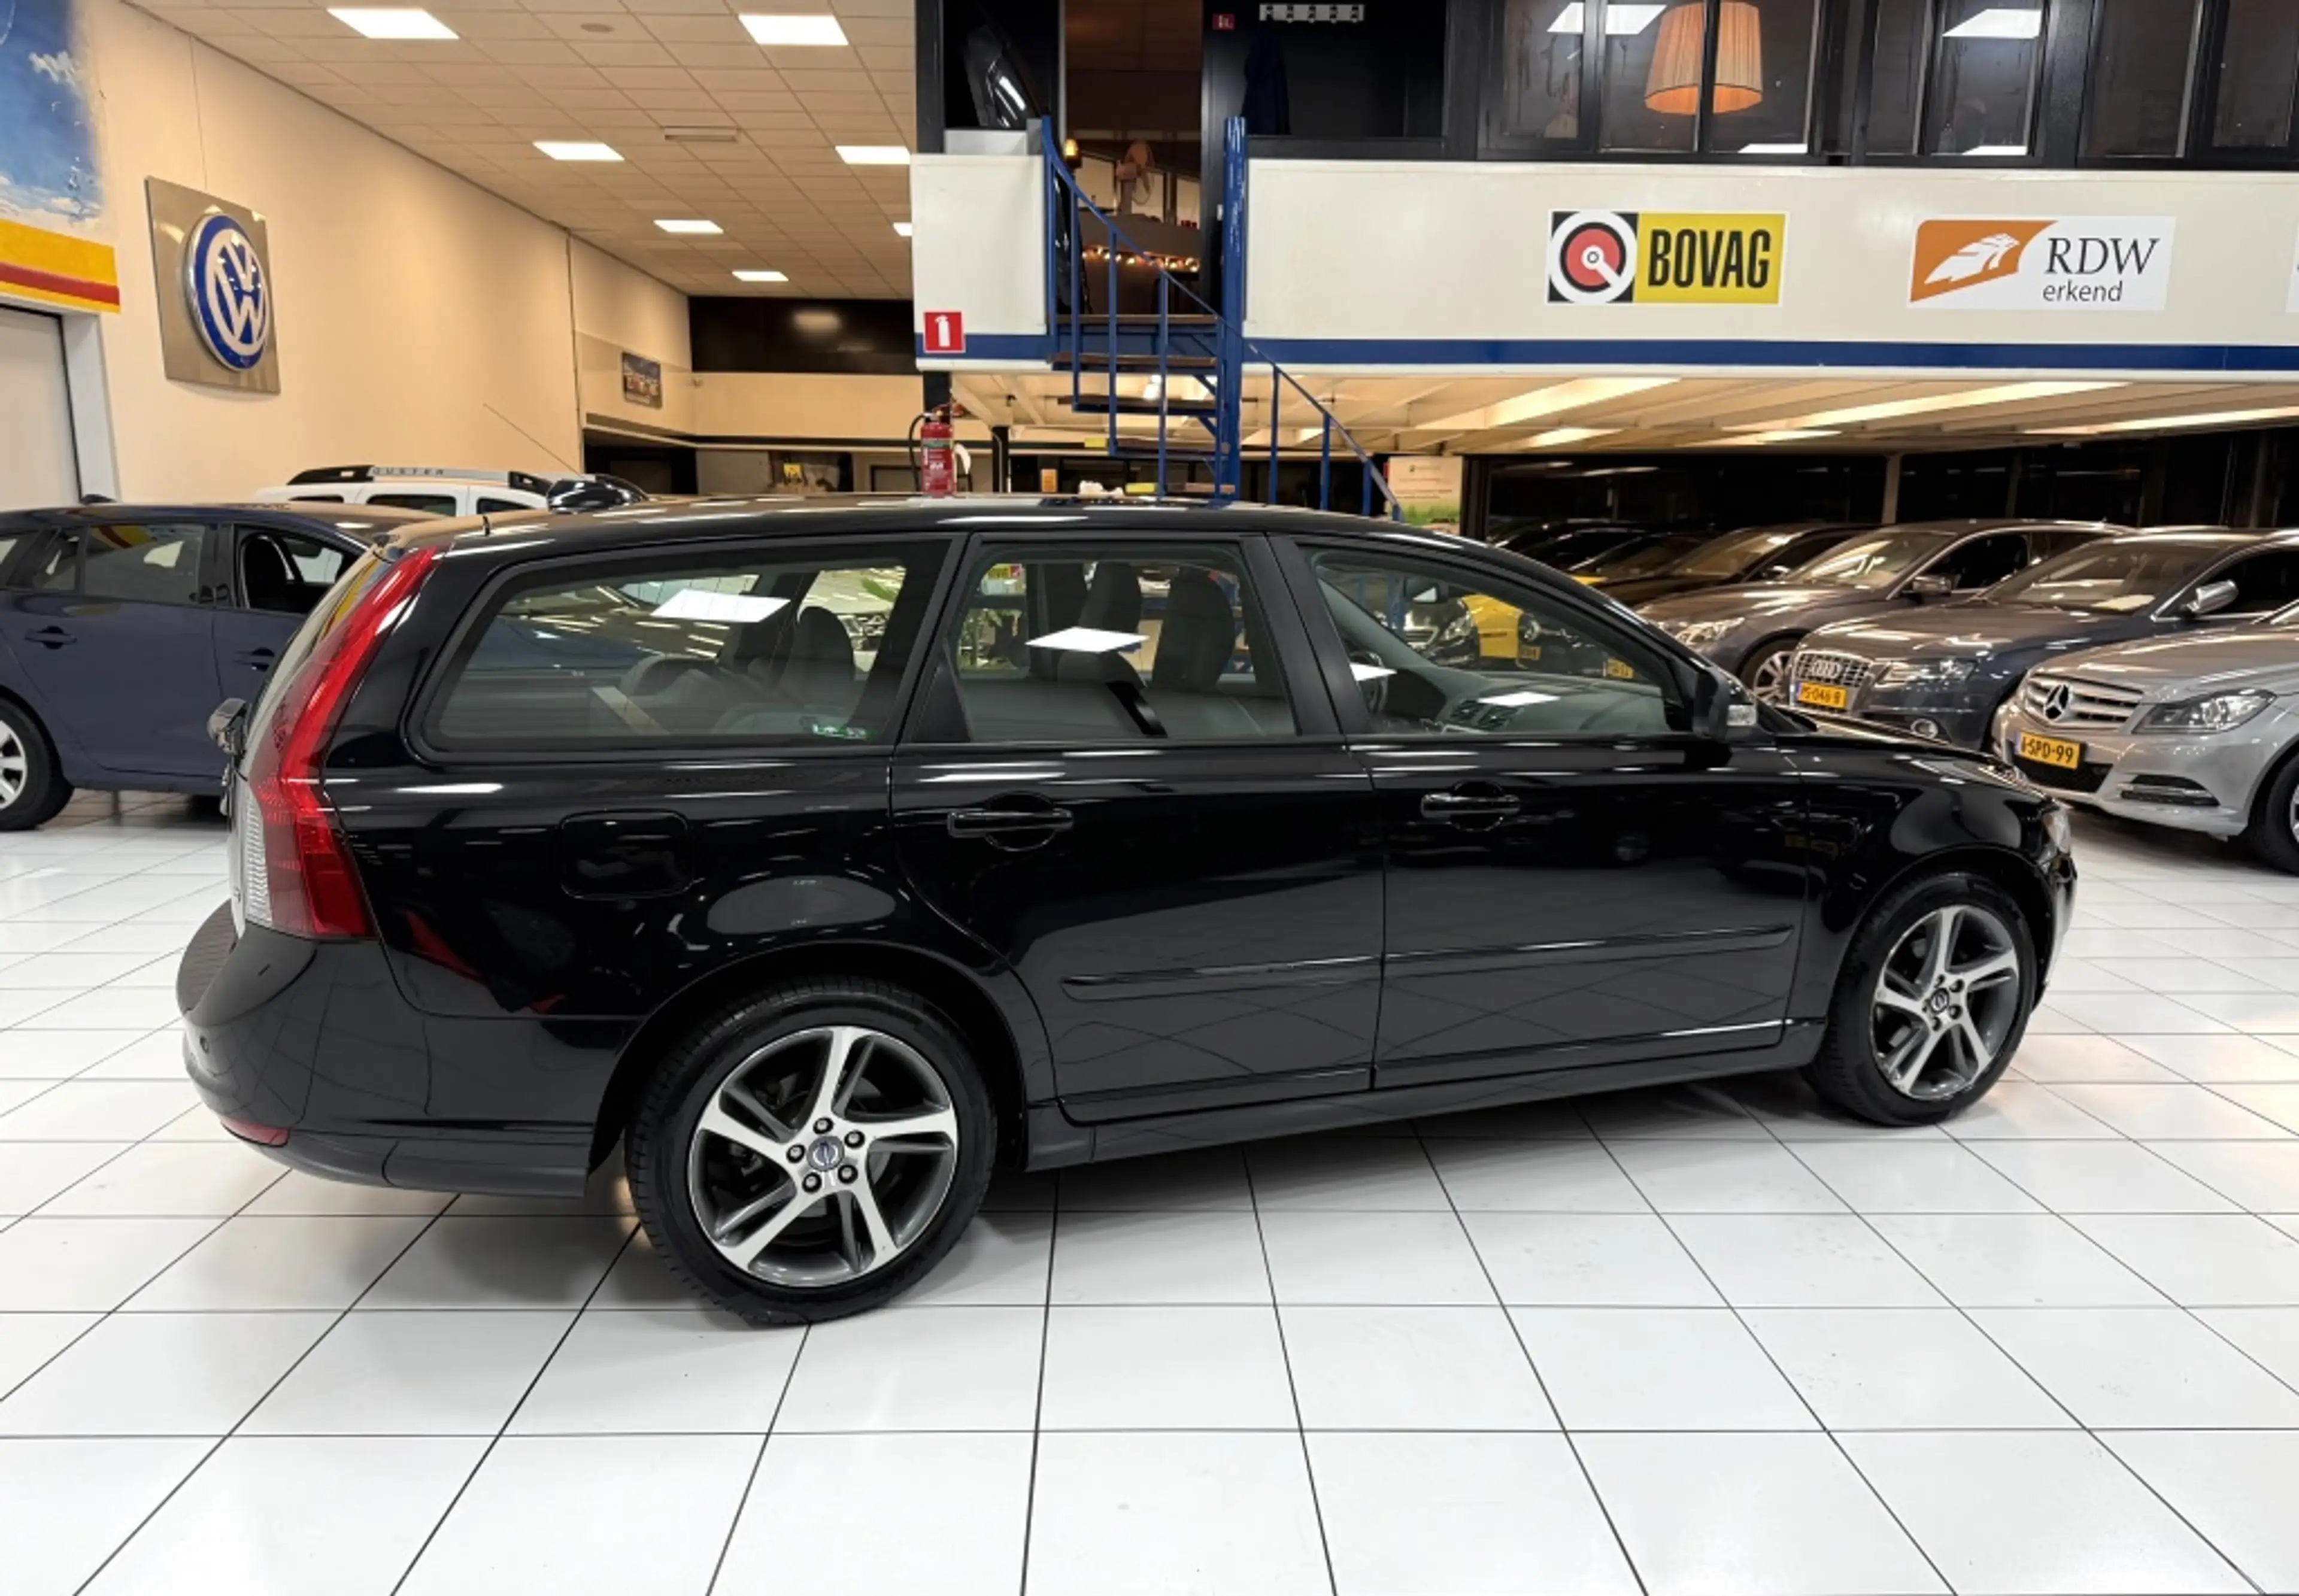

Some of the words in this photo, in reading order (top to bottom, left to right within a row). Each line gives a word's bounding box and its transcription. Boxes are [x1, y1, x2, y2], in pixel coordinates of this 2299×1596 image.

[1648, 229, 1771, 288] BOVAG
[2044, 238, 2160, 274] RDW
[2043, 279, 2122, 302] erkend
